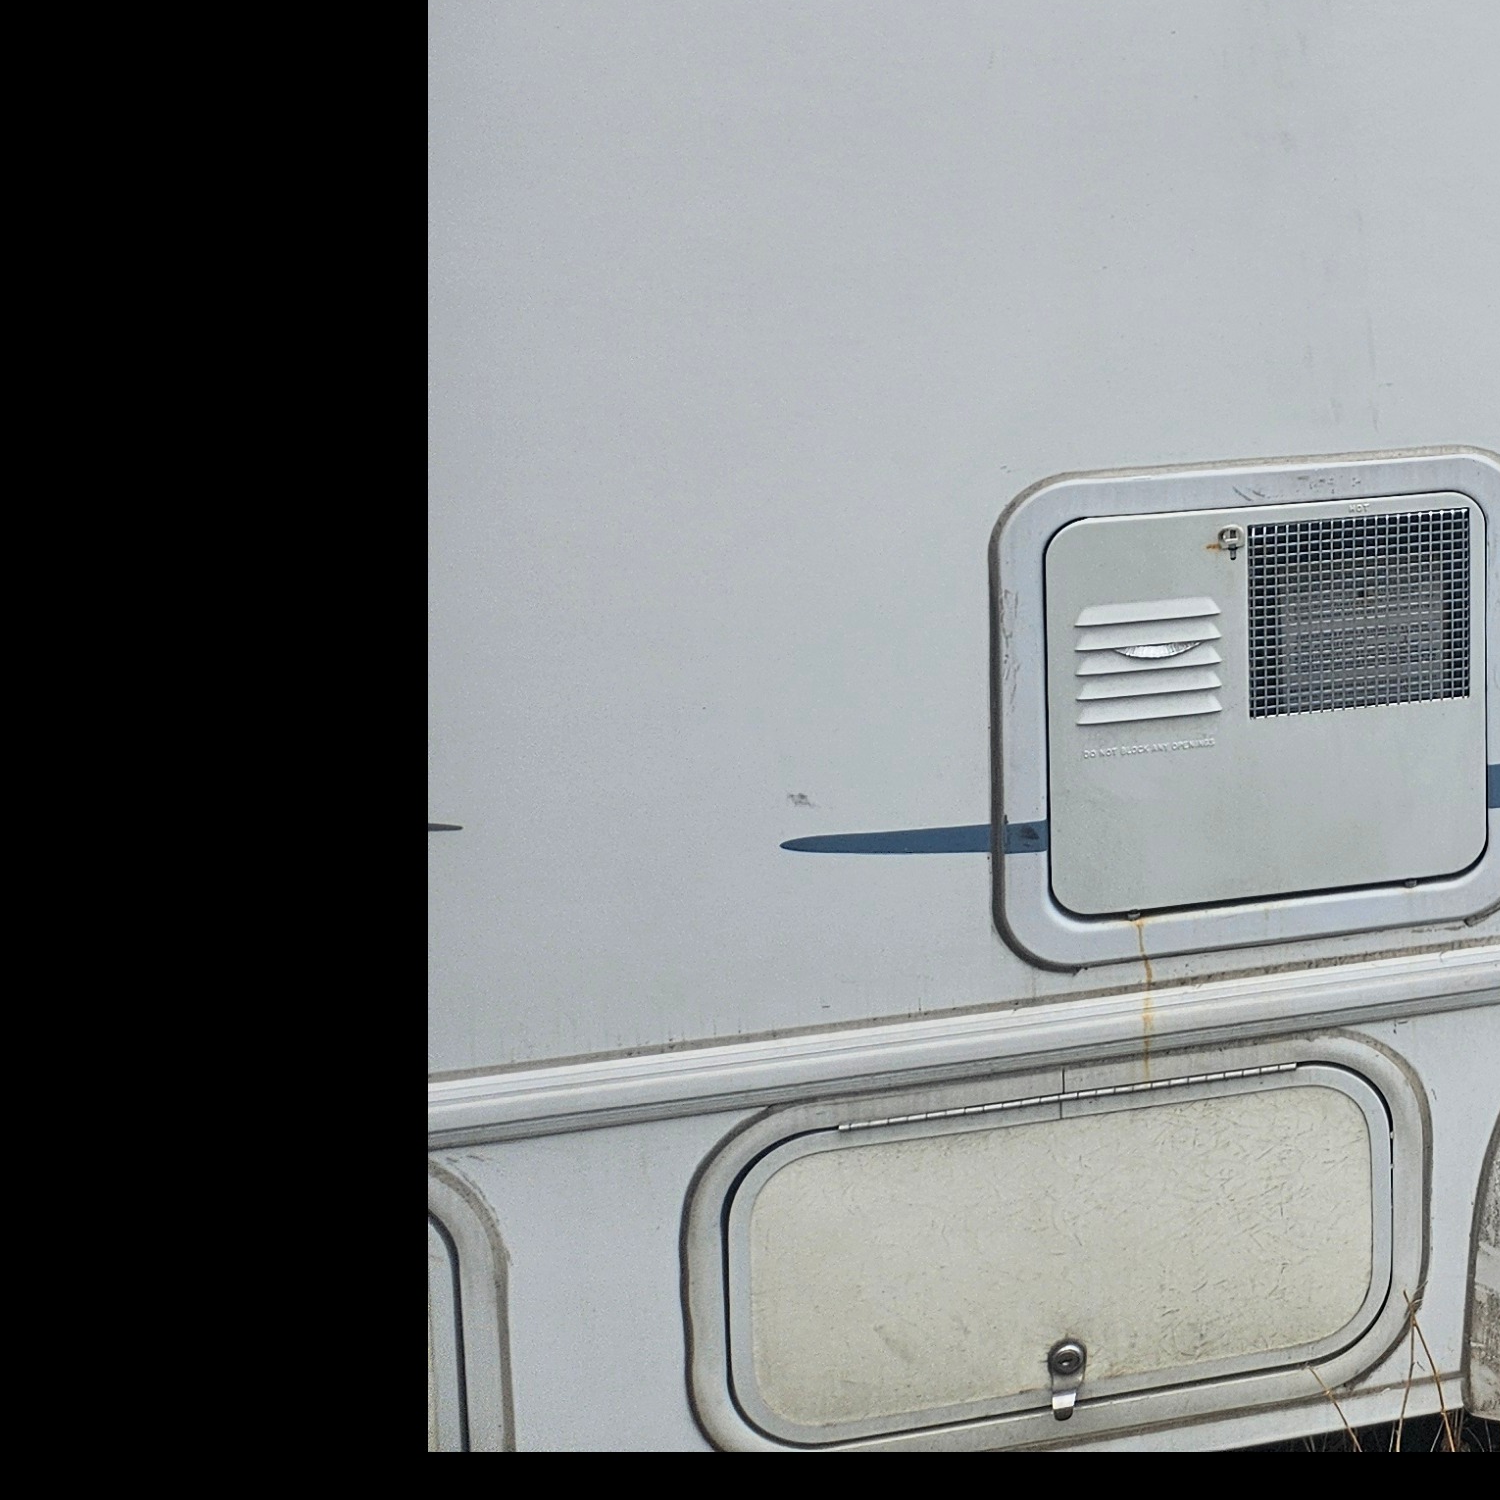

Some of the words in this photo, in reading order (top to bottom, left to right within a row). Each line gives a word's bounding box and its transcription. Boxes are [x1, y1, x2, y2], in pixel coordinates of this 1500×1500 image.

[1083, 749, 1096, 759] DO
[1100, 747, 1118, 757] NOT
[1121, 744, 1150, 756] BLOCK
[1151, 743, 1170, 753] ANY
